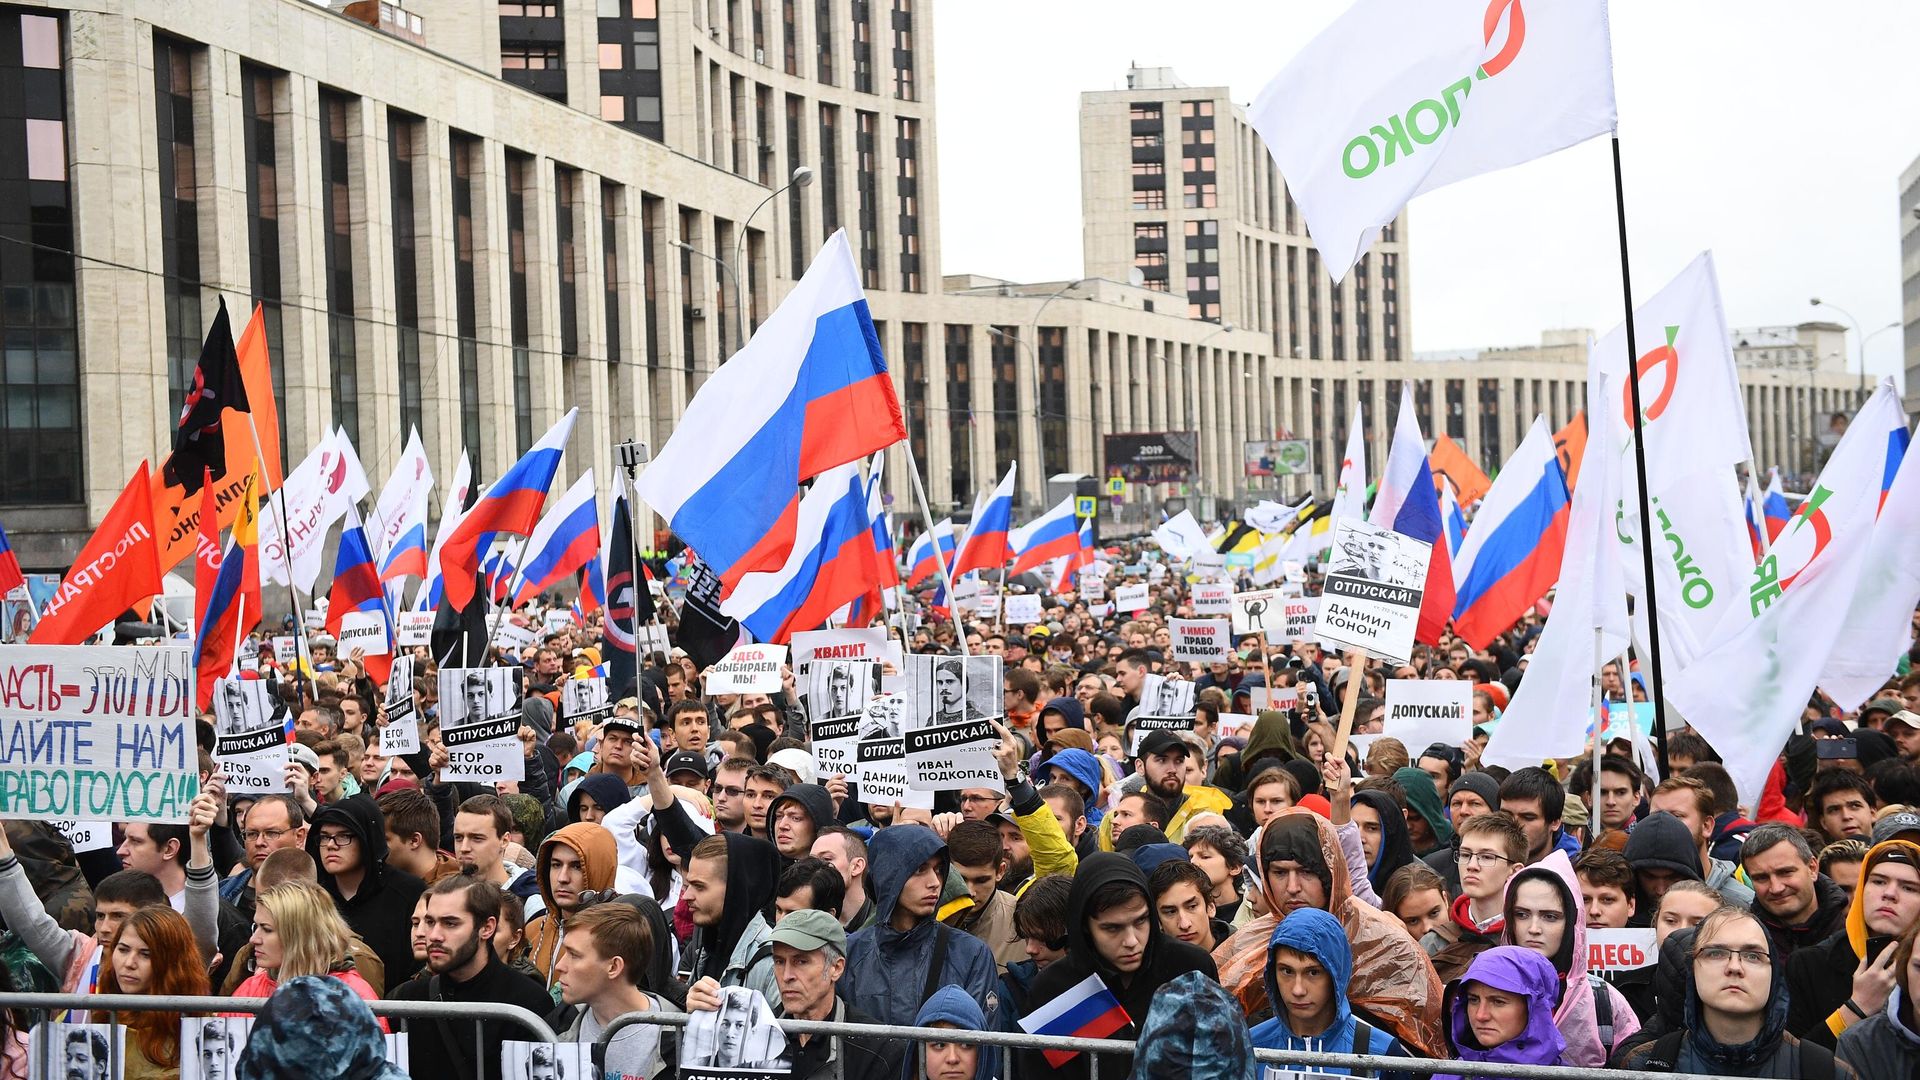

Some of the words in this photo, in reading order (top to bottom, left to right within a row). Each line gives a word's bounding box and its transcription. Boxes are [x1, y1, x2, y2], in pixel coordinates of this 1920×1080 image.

[1139, 445, 1164, 455] 2019
[1334, 580, 1412, 603] ОТПУСКАЙ!
[1285, 605, 1308, 615] ДЕСЬ
[1328, 603, 1391, 630] ДАНИИЛ
[411, 616, 431, 624] ЗДЕСЬ
[1286, 615, 1317, 625] ИРАЕМ
[1326, 615, 1377, 638] КОНОН
[340, 625, 382, 642] ДОПУСКАЙ!
[1180, 626, 1186, 635] Я
[1187, 626, 1216, 635] ИМЕЮ
[1285, 627, 1305, 636] МЫ!
[1183, 637, 1213, 646] ПРАВО
[731, 650, 765, 662] ЗДЕСЬ
[813, 642, 866, 659] ХВАТИТ
[1176, 645, 1187, 655] НА
[1189, 646, 1224, 655] ВЫБОР!
[715, 662, 777, 673] ВЫБИРАЕМ
[732, 674, 757, 684] МЫ!
[1391, 701, 1465, 719] ДОПУСКАЙ!
[818, 721, 860, 737] ОТПУСКА
[1140, 719, 1190, 729] ОТПУСКАЙ!
[386, 729, 404, 739] ЕГОР
[448, 721, 516, 742] ОТПУСКАЙ!
[914, 723, 994, 747] ОТПУСКАЙ!
[116, 722, 185, 769] НАМ
[221, 732, 278, 752] ОТПУСКАЙ!
[819, 748, 845, 760] ЕГОР
[863, 743, 905, 758] ОТПУСК
[450, 752, 485, 763] ЕГОР
[224, 761, 251, 774] ЕГОР
[449, 763, 503, 775] ЖУКОВ
[818, 761, 857, 775] ЖУКО
[917, 760, 953, 770] ИВАН
[224, 774, 271, 787] ЖУКОВ
[918, 768, 999, 782] ПОДКОПАЕВ
[863, 784, 904, 797] КОНОН
[54, 820, 77, 833] ГОР
[1587, 944, 1645, 970] ДЕСЬ
